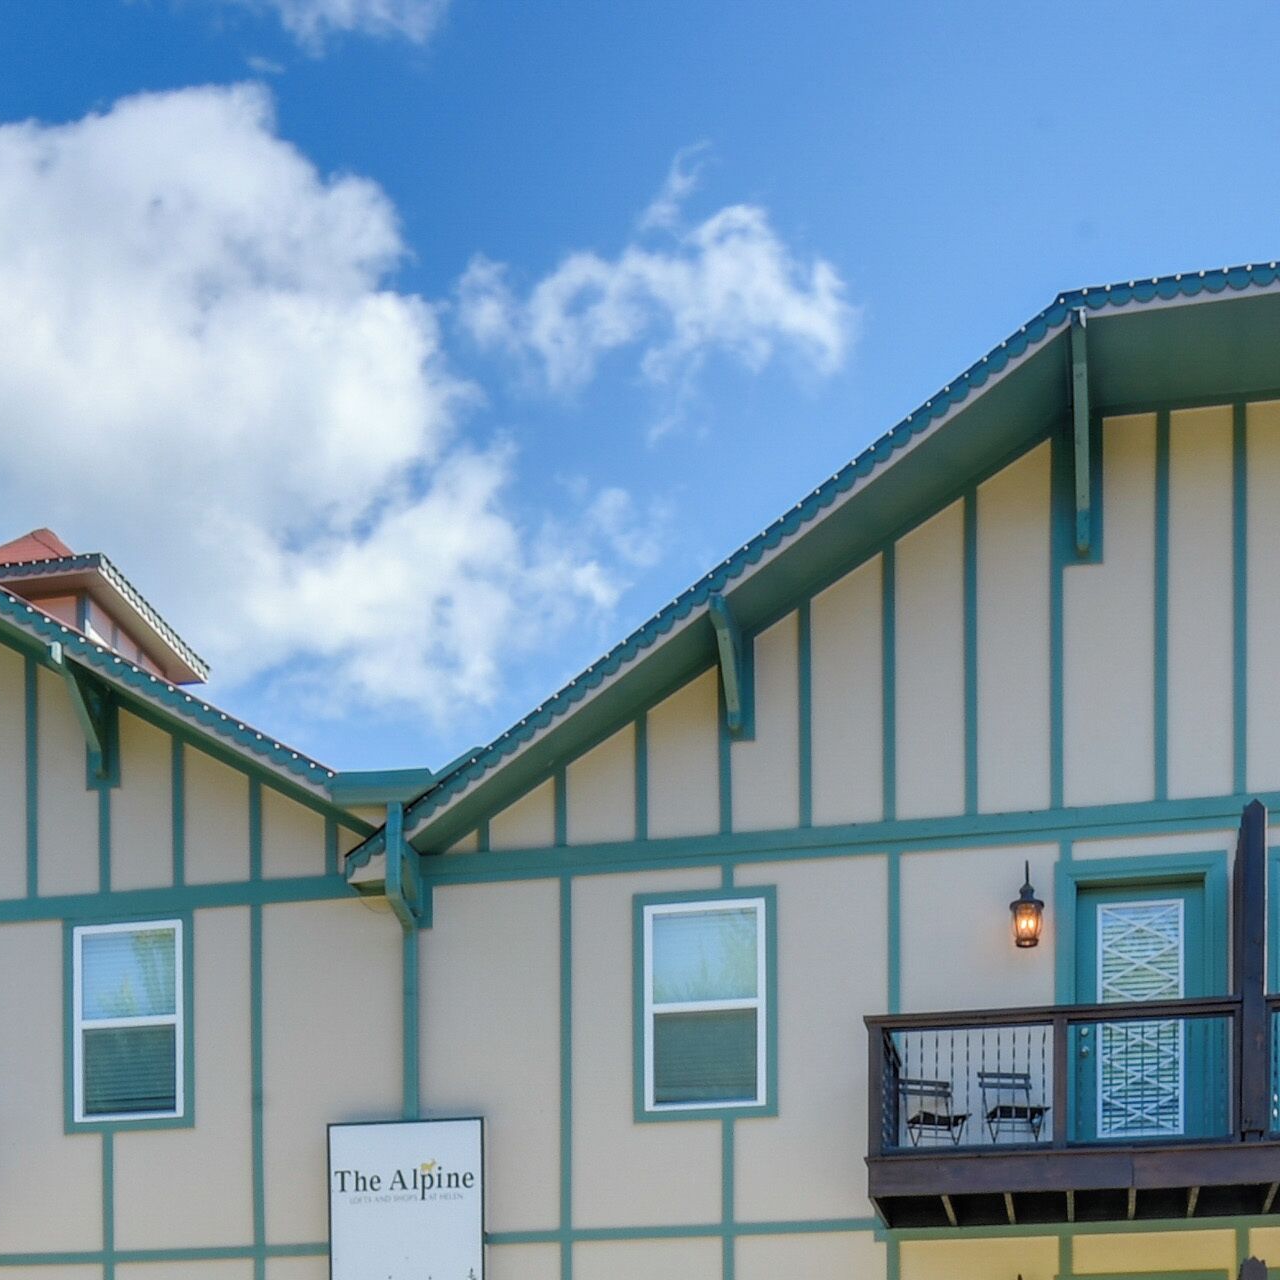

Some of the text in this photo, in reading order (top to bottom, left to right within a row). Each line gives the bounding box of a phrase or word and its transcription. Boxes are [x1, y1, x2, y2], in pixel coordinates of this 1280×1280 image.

[334, 1166, 474, 1201] The Alpine
[375, 1195, 392, 1203] AND
[439, 1192, 464, 1200] HELEN
